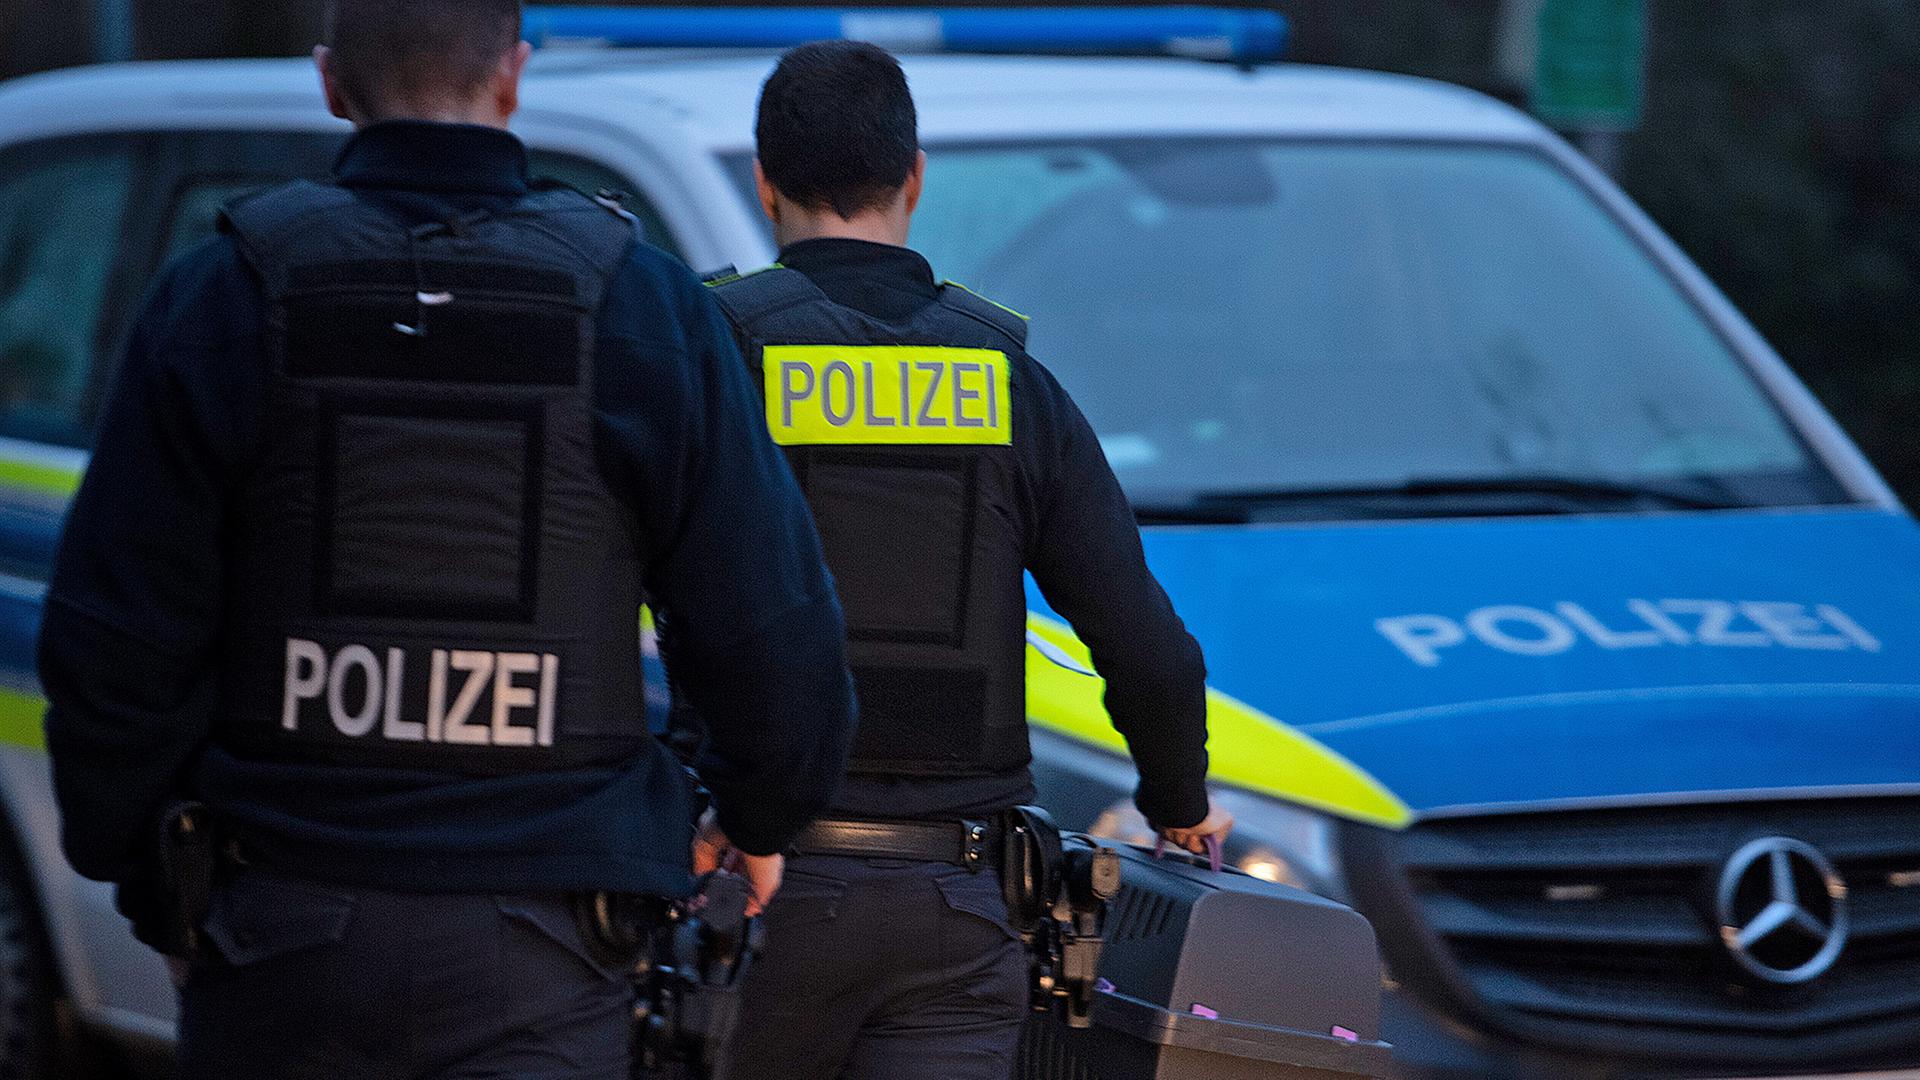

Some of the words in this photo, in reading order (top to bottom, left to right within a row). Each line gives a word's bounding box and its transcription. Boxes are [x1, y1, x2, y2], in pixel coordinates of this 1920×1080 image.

[780, 360, 998, 427] POLIZEI
[1374, 598, 1882, 667] POLIZEI
[281, 638, 559, 746] POLIZEI
